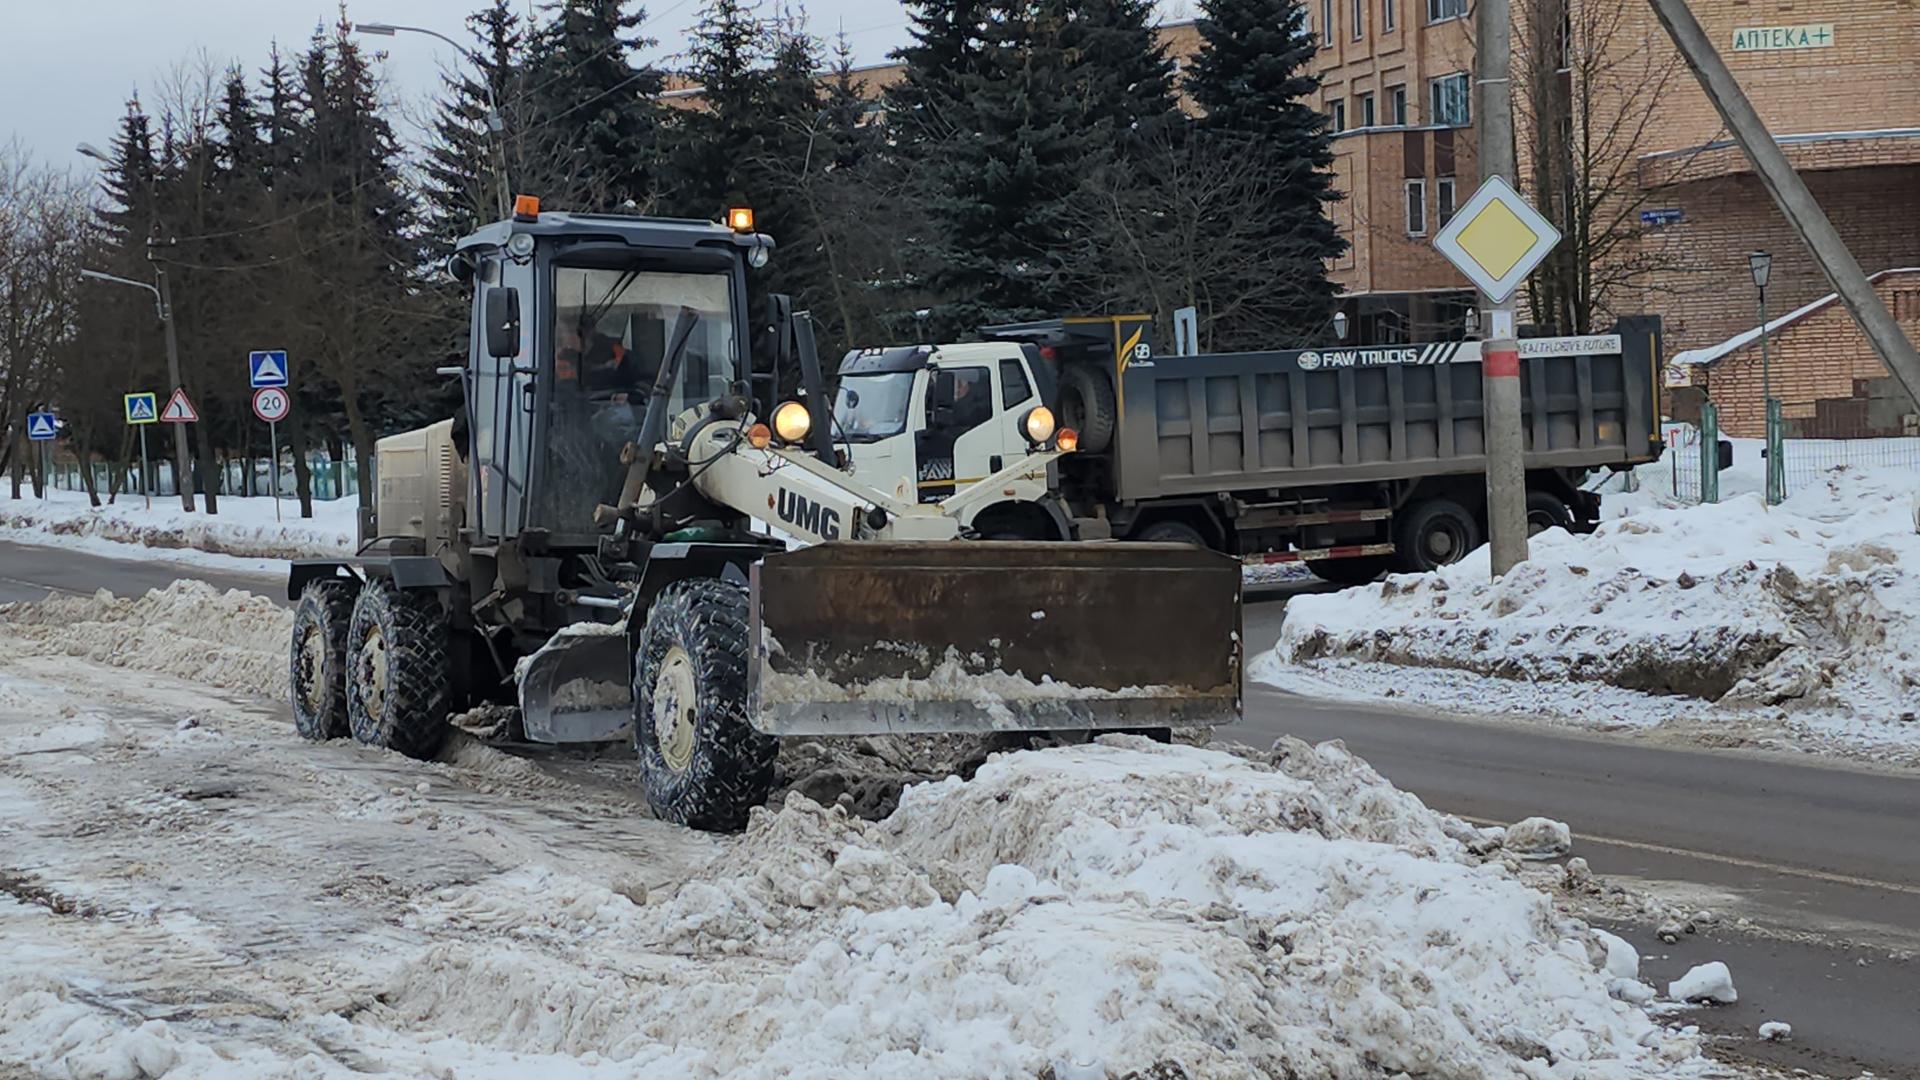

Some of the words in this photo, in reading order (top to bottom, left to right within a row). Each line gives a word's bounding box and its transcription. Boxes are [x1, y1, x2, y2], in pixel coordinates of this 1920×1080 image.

[1583, 338, 1616, 351] FUTURE
[1322, 351, 1357, 367] FAW
[1359, 348, 1418, 365] TRUCKS
[261, 396, 282, 411] 20
[777, 486, 840, 541] UMG
